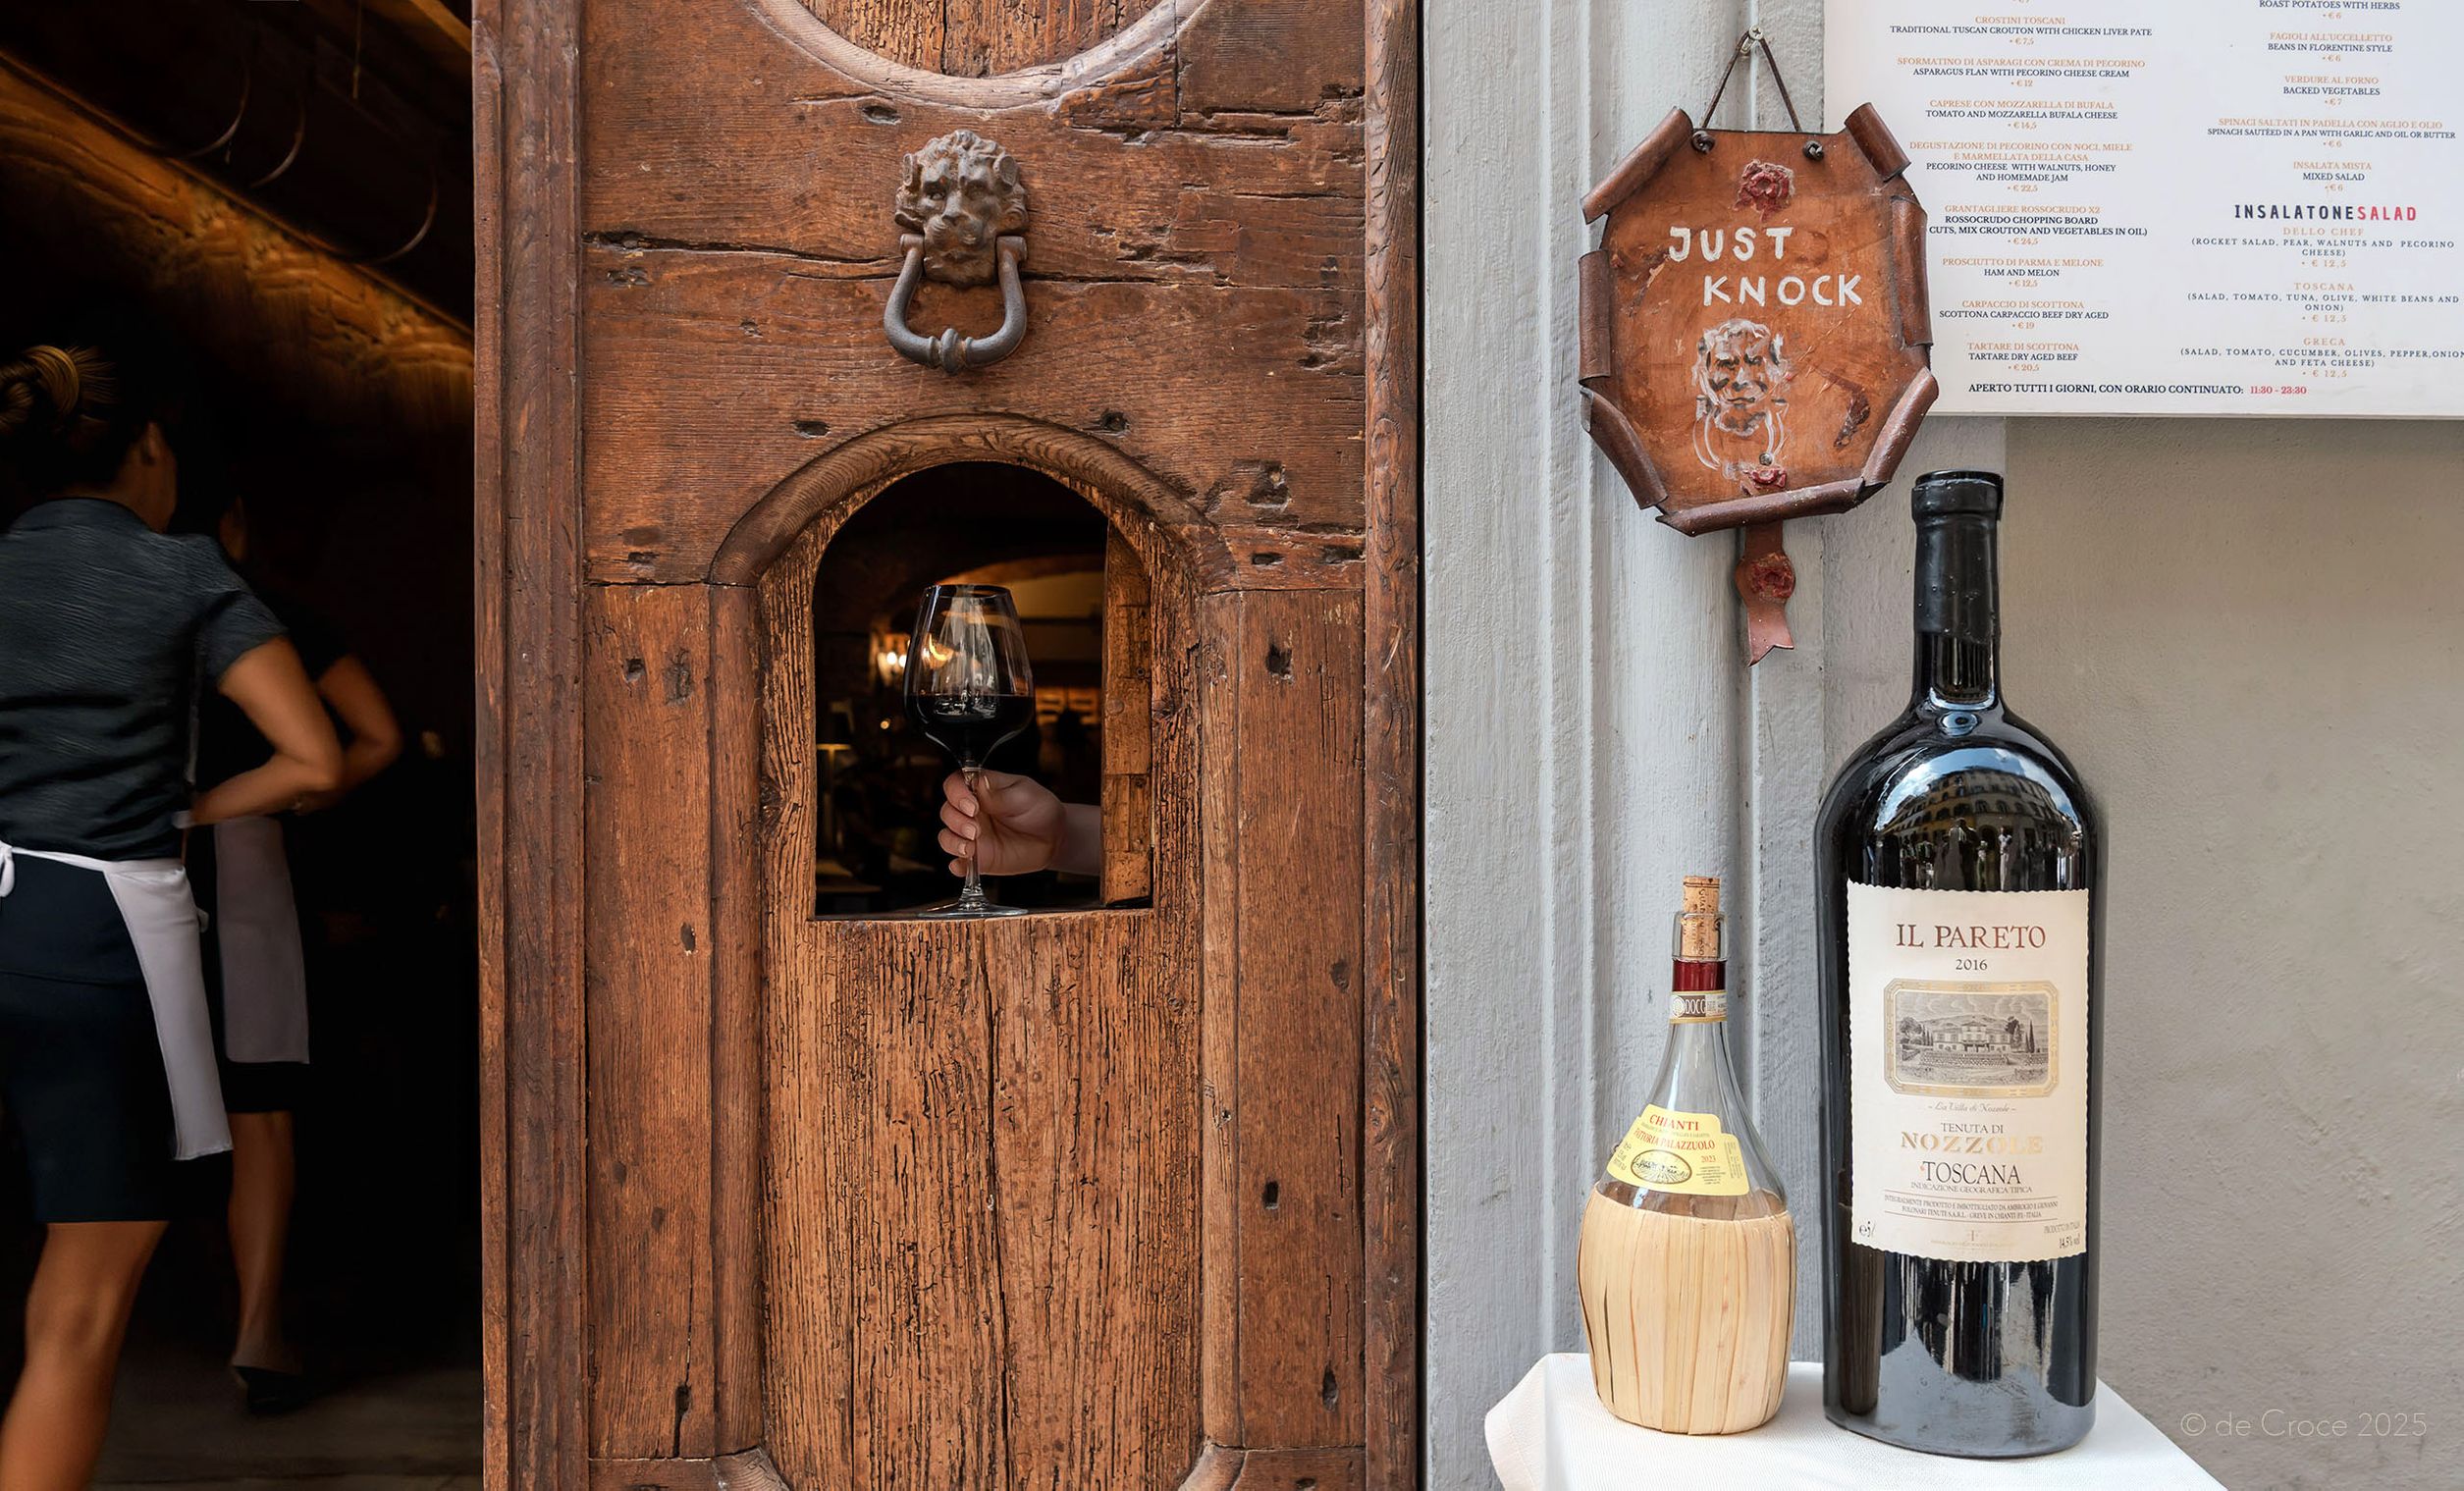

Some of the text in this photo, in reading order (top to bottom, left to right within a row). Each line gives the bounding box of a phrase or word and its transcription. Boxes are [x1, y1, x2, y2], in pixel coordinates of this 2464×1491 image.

[2292, 0, 2341, 9] POTATOES
[2342, 1, 2369, 10] WITH
[2371, 1, 2400, 11] HERBS
[1975, 16, 2066, 27] CROSTINI TOSCANI
[1890, 26, 1952, 34] TRADITIONAL
[1952, 26, 1988, 34] TUSCAN
[2035, 27, 2061, 35] WITH
[2103, 27, 2129, 36] LIVER
[2309, 43, 2365, 52] FLORENTINE
[2366, 44, 2393, 53] STYLE
[1912, 68, 1964, 77] ASPARAGUS
[1965, 68, 1989, 77] FLAN
[2016, 69, 2062, 78] PECORINO
[2063, 69, 2098, 78] CHEESE
[2284, 76, 2380, 85] VERDURE AL FORNO
[2283, 86, 2381, 96] BACKED VEGETABLES
[1988, 110, 2048, 119] MOZZARELLA
[2084, 111, 2118, 120] CHEESE
[2343, 130, 2374, 138] GARLIC
[2410, 131, 2423, 139] OR
[1926, 162, 1973, 171] PECORINO
[2011, 163, 2036, 172] WITH
[2293, 161, 2372, 171] INSALATA MISTA
[1976, 173, 2068, 184] AND HOMEMADE JAM
[2303, 172, 2365, 182] MIXED SALAD
[1944, 204, 2101, 215] GRANTAGLIERE ROSSOCRUDO X2
[1945, 215, 2011, 224] ROSSOCRUDO
[2012, 216, 2063, 225] CHOPPING
[1958, 226, 1978, 235] MIX
[1979, 226, 2028, 235] CROUTON
[2052, 227, 2114, 236] VEGETABLES
[1668, 226, 1794, 263] JUST
[2317, 239, 2367, 247] WALNUTS
[1942, 257, 2005, 268] PROSCIUTTO
[2018, 258, 2053, 268] PARMA
[2062, 258, 2104, 267] MELONE
[1703, 274, 1863, 306] KNOCK
[2294, 283, 2355, 293] TOSCANA
[2401, 294, 2434, 303] BEANS
[1961, 299, 2085, 310] CARPACCIO DI SCOTTONA
[1939, 310, 1989, 319] SCOTTONA
[1990, 310, 2041, 319] CARPACCIO
[2084, 311, 2110, 320] AGED
[2303, 337, 2345, 346] GRECA
[1966, 342, 2079, 352] TARTARE DI SCOTTONA
[1967, 352, 2009, 361] TARTARE
[2010, 352, 2029, 361] DRY
[1968, 383, 2012, 393] APERTO
[2013, 384, 2047, 393] TUTTI
[2049, 384, 2054, 393] I
[2098, 384, 2122, 394] CON
[2124, 385, 2167, 394] ORARIO
[2251, 386, 2273, 395] 11:30
[2280, 386, 2307, 395] 23:30
[1896, 924, 2046, 949] IL PARETO
[1955, 959, 1988, 971] 2016
[1649, 1114, 1699, 1131] CHIANTI
[1941, 1122, 2004, 1135] TENUTA DI
[1661, 1138, 1716, 1150] PALAZZUOLO
[1901, 1131, 2044, 1154] NOZZOLE
[1922, 1161, 2021, 1185] TOSCANA
[1910, 1181, 1958, 1193] INDICAZIONE
[1960, 1185, 2009, 1194] GEOGRAFICA
